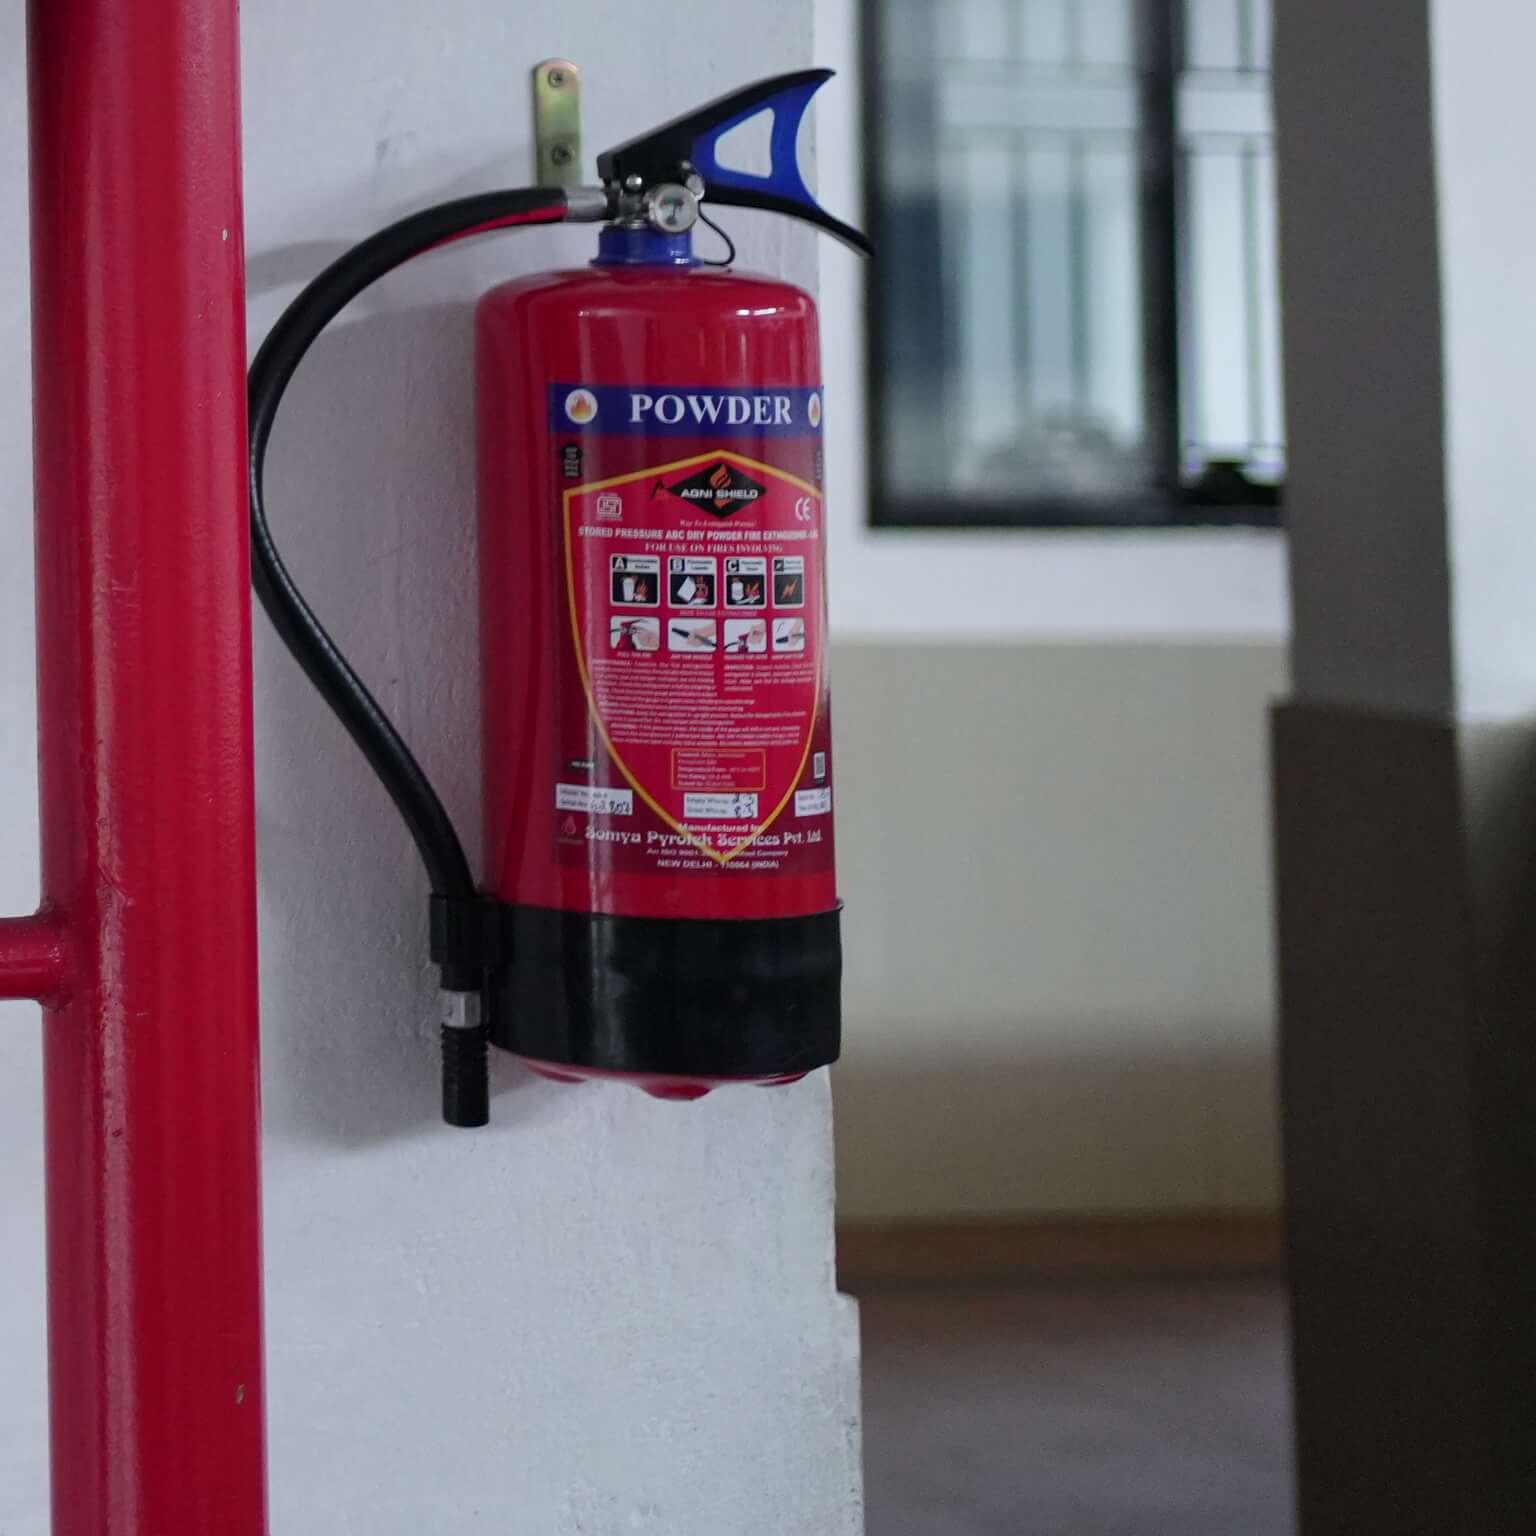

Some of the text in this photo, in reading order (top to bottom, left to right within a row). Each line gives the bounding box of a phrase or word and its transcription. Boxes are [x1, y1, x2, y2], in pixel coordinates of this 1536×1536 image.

[629, 394, 793, 425] POWDER
[681, 489, 758, 500] AGNI SHIELD
[578, 526, 613, 538] STORED
[615, 528, 664, 539] PRESSURE
[665, 529, 685, 540] ABC
[687, 530, 705, 541] DRY
[706, 530, 744, 541] POWDER
[744, 530, 762, 541] FIRE
[645, 543, 783, 554] FOR USE ON FIRES INVOLVING
[679, 823, 750, 833] Manufactured
[585, 825, 641, 844] Somya
[718, 833, 779, 847] Services
[657, 859, 681, 868] NEW
[683, 860, 712, 869] DELHI
